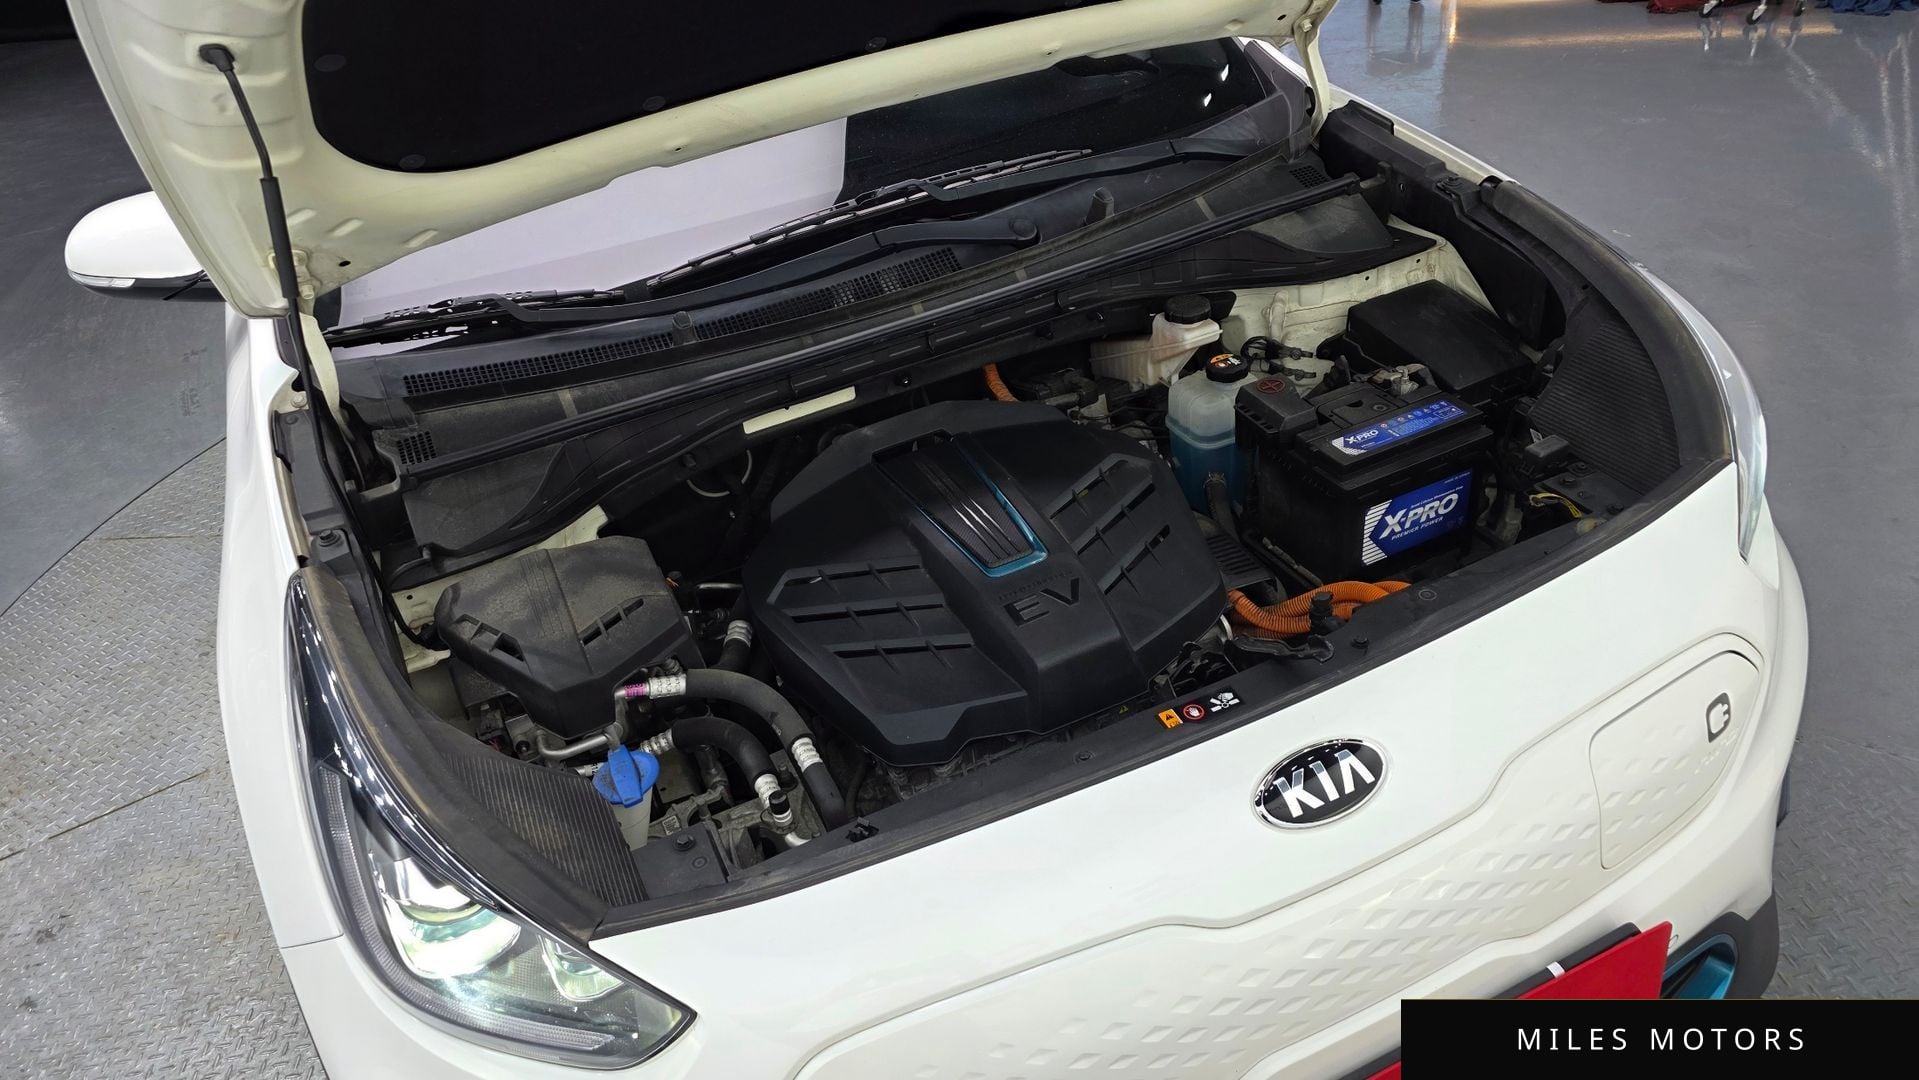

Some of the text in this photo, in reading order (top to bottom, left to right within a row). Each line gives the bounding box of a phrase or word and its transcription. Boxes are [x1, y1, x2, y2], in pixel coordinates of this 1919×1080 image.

[1345, 429, 1378, 444] X-PRO
[1379, 493, 1459, 540] X-PRO
[1003, 578, 1080, 627] EV
[1273, 749, 1376, 818] KIA
